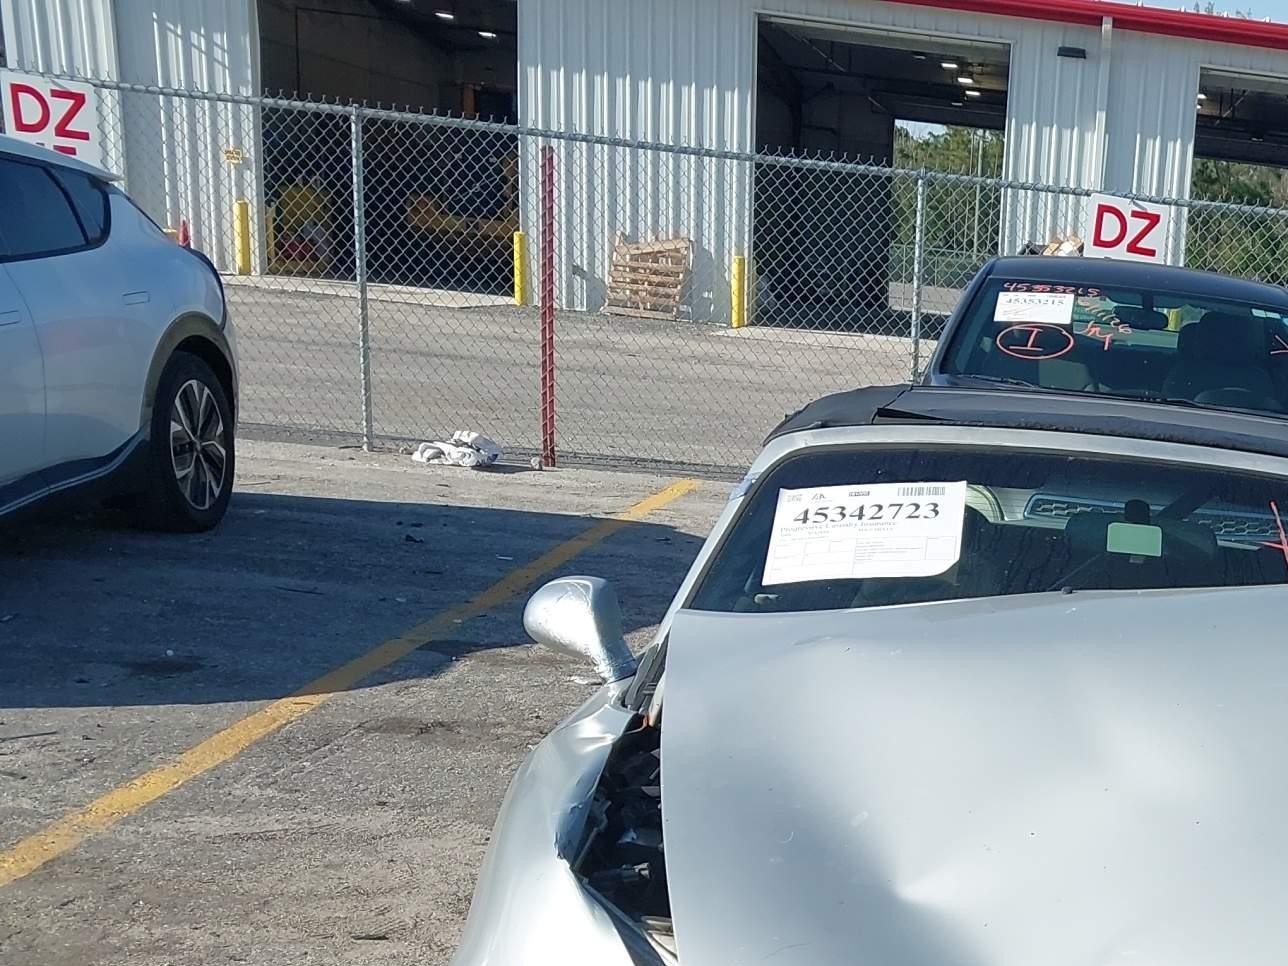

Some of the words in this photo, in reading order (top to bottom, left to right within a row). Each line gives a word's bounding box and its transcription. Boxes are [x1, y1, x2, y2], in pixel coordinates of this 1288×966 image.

[10, 83, 90, 141] DZ
[1092, 203, 1161, 257] DZ
[793, 502, 940, 524] 45342723
